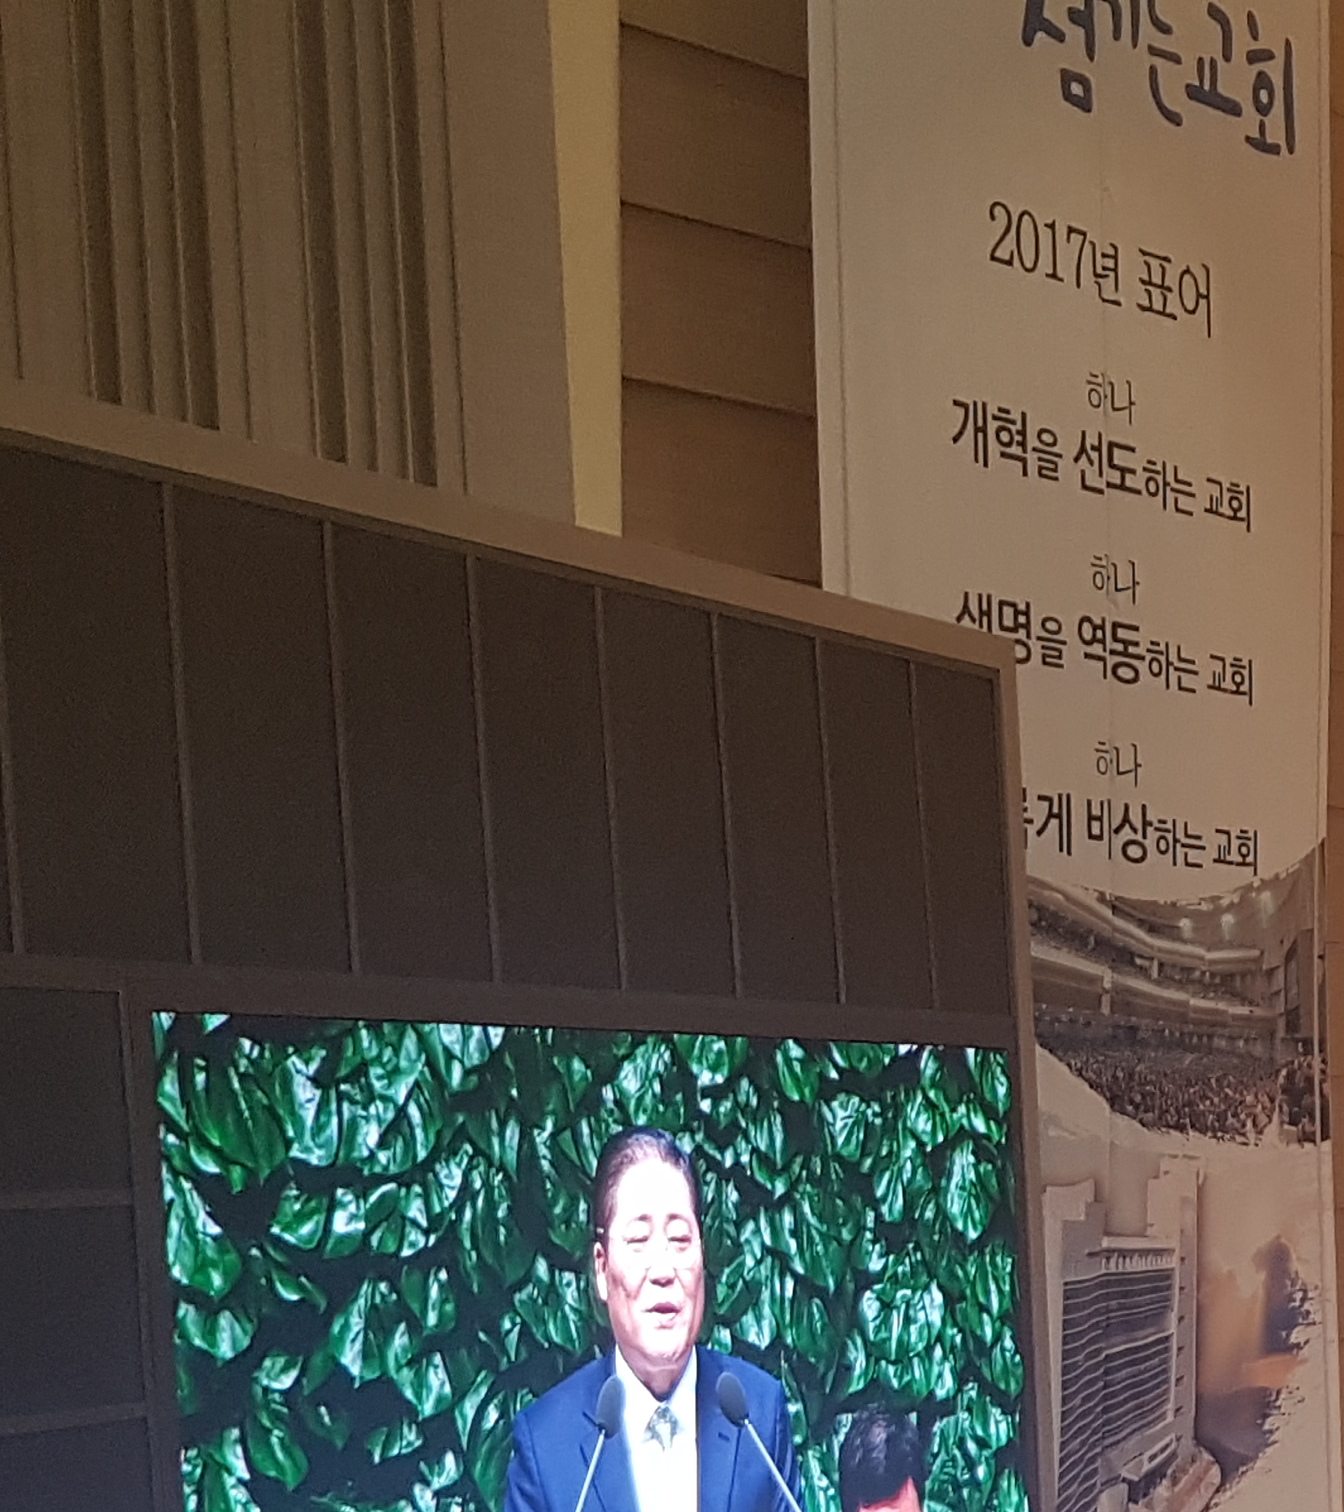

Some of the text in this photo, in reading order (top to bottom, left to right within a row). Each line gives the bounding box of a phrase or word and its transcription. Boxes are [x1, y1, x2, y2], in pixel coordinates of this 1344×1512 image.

[988, 200, 1212, 338] 2017년 표어
[1087, 371, 1136, 425] 하나
[952, 399, 1251, 533] 개혁을 선도하는 교회
[1090, 552, 1140, 604] 하나
[1077, 615, 1199, 694] 역동하는
[1206, 653, 1253, 706] 교회
[1093, 740, 1142, 787] 하나
[1086, 798, 1203, 869] 비상하는
[1212, 827, 1258, 875] 교회
